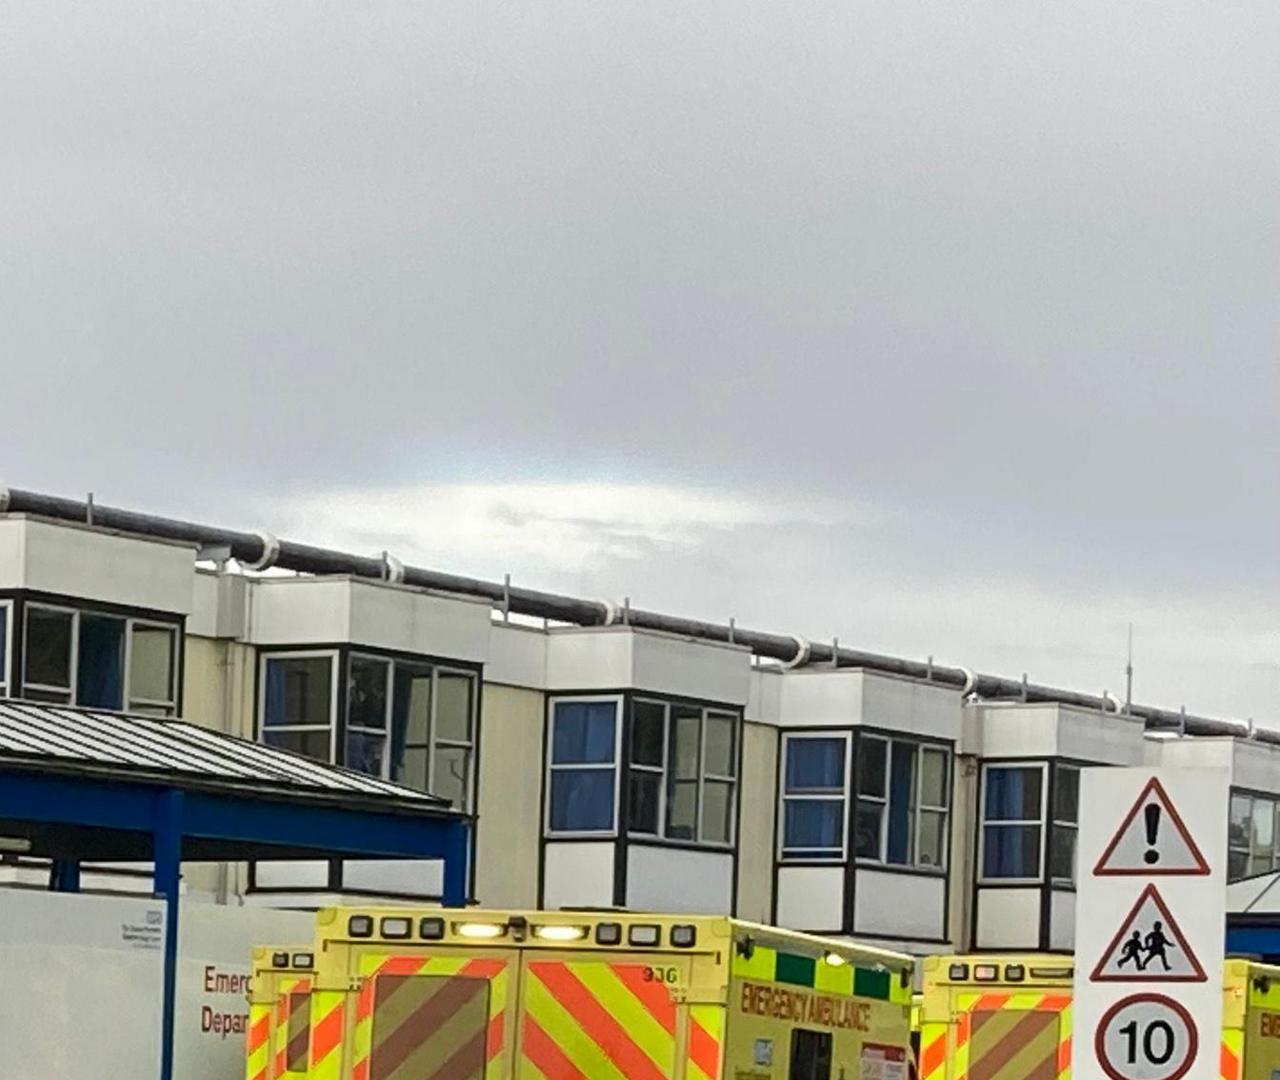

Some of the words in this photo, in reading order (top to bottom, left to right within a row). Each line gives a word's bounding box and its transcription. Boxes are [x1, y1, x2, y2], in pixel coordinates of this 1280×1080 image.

[742, 982, 807, 1023] EMERGENCY
[807, 994, 871, 1032] AMBULANCE
[1119, 1020, 1174, 1065] 10
